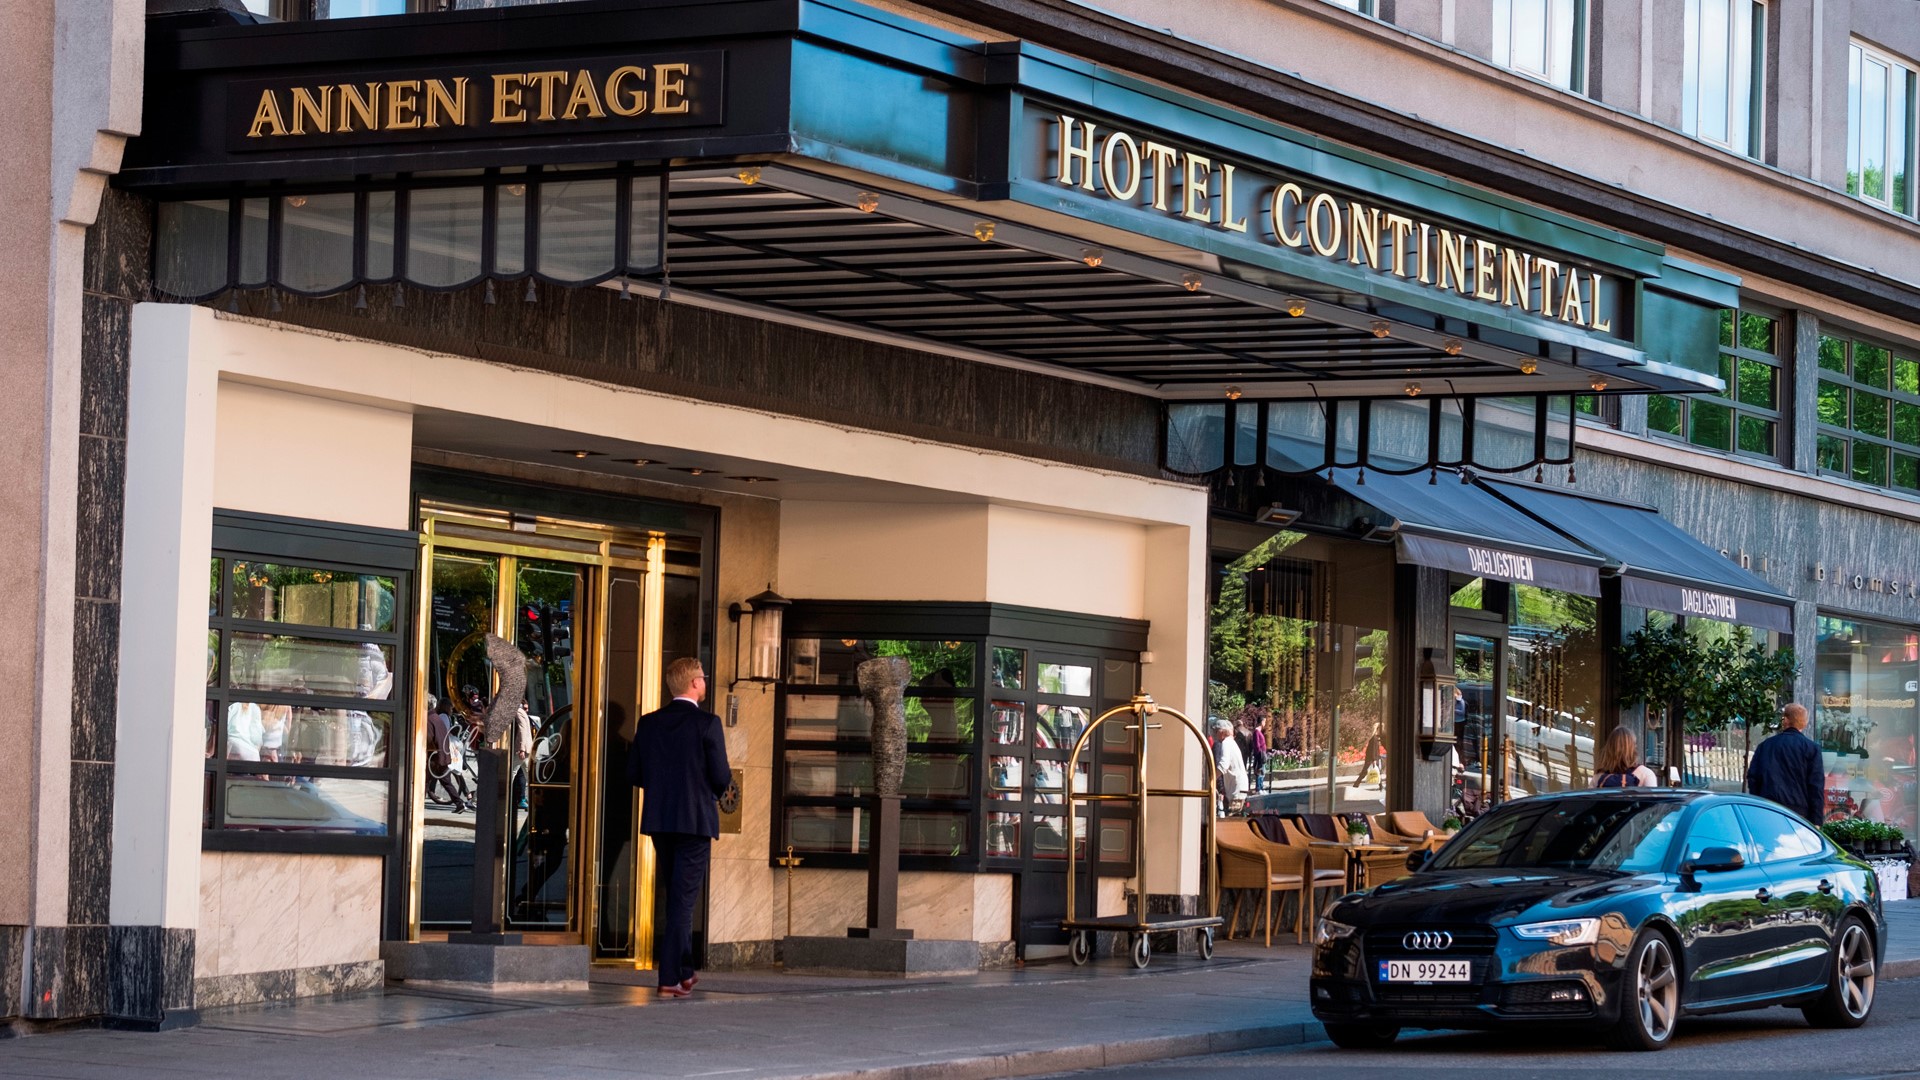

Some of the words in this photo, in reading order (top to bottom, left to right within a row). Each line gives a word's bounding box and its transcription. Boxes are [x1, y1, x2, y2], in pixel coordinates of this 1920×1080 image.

[246, 77, 469, 137] ANNEN
[490, 63, 689, 123] ETAGE
[1056, 115, 1248, 233] HOTEL
[1270, 182, 1612, 333] CONTINENTAL
[1467, 547, 1534, 582] DAGLIGSTUEN
[1681, 588, 1737, 620] DAGLIGSTUEN
[1390, 963, 1411, 979] DN
[1418, 963, 1467, 979] 99244
